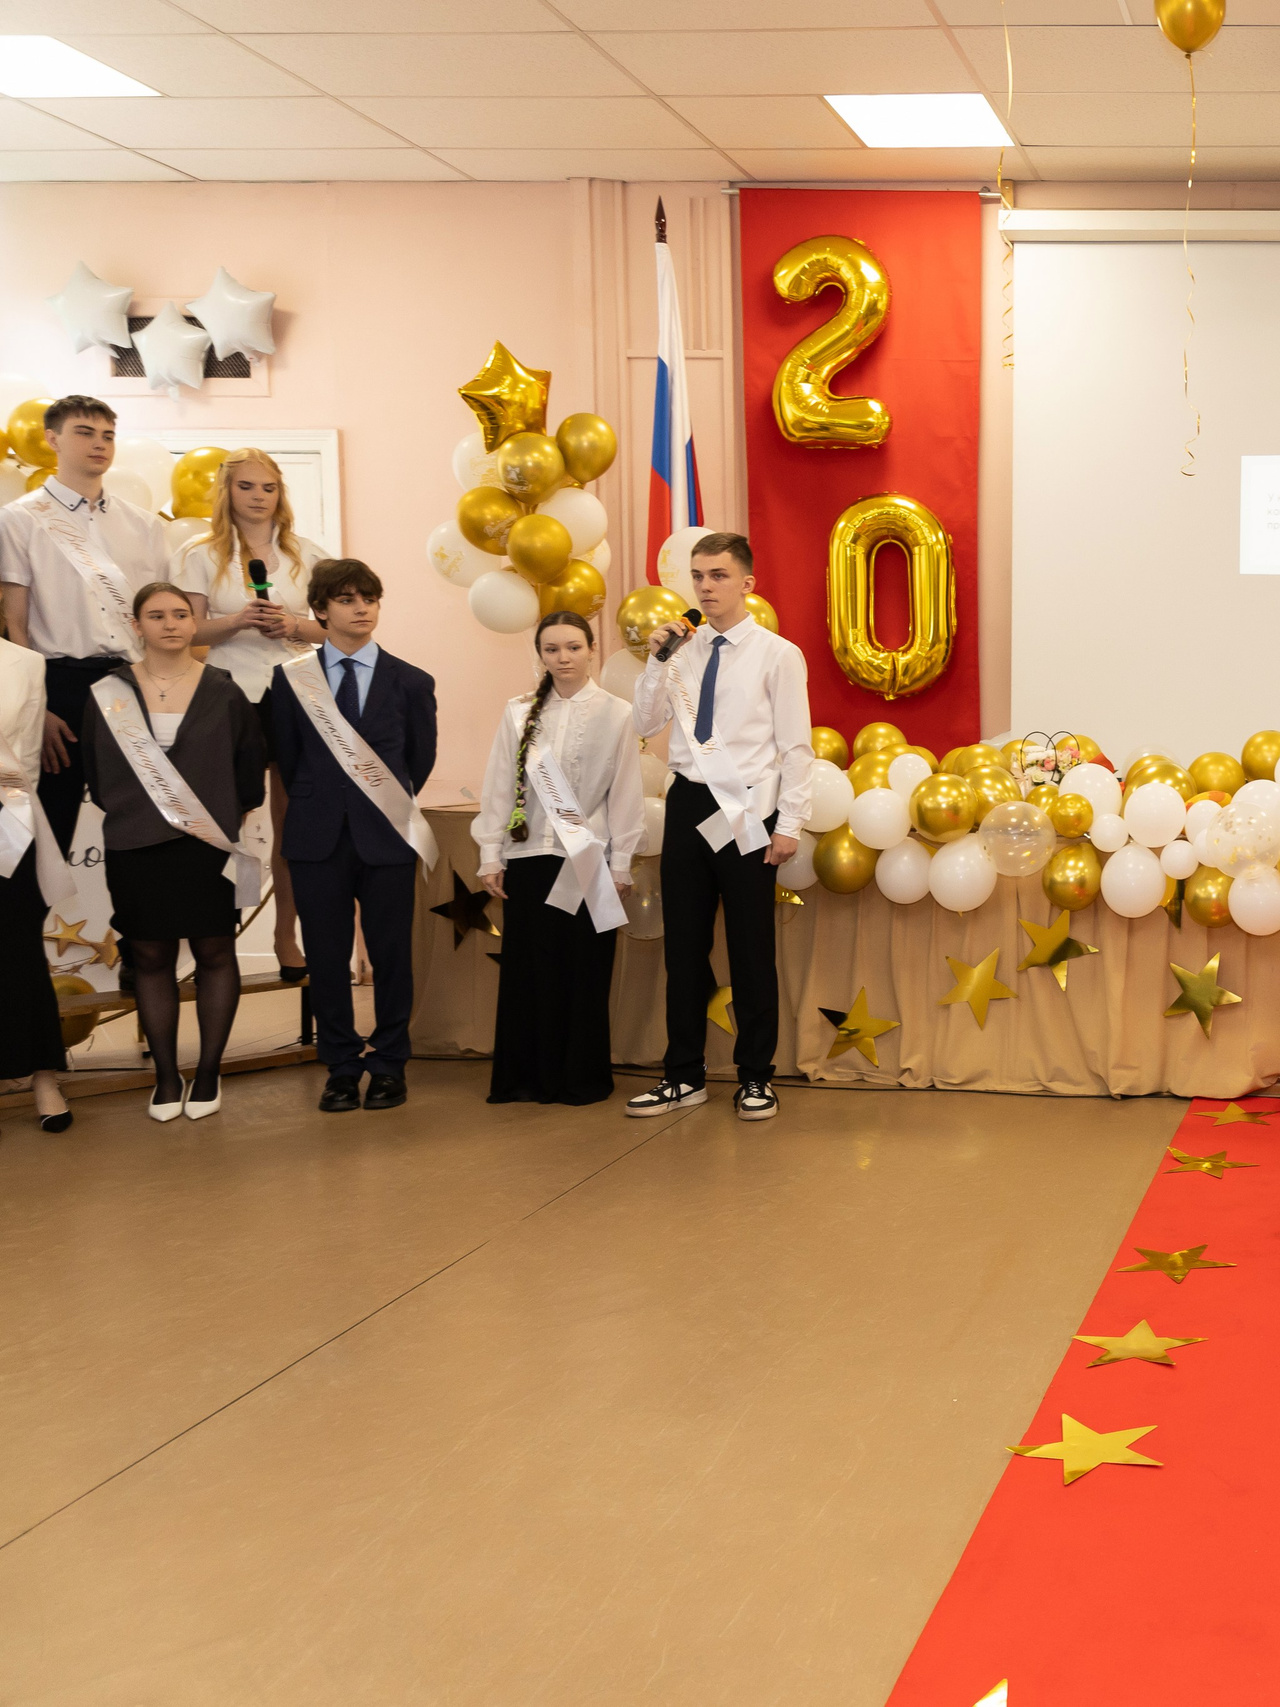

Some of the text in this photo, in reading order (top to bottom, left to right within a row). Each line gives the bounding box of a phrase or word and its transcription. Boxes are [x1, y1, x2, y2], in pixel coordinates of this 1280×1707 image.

[772, 234, 892, 449] 2
[1267, 493, 1274, 502] У
[352, 760, 390, 788] 2026
